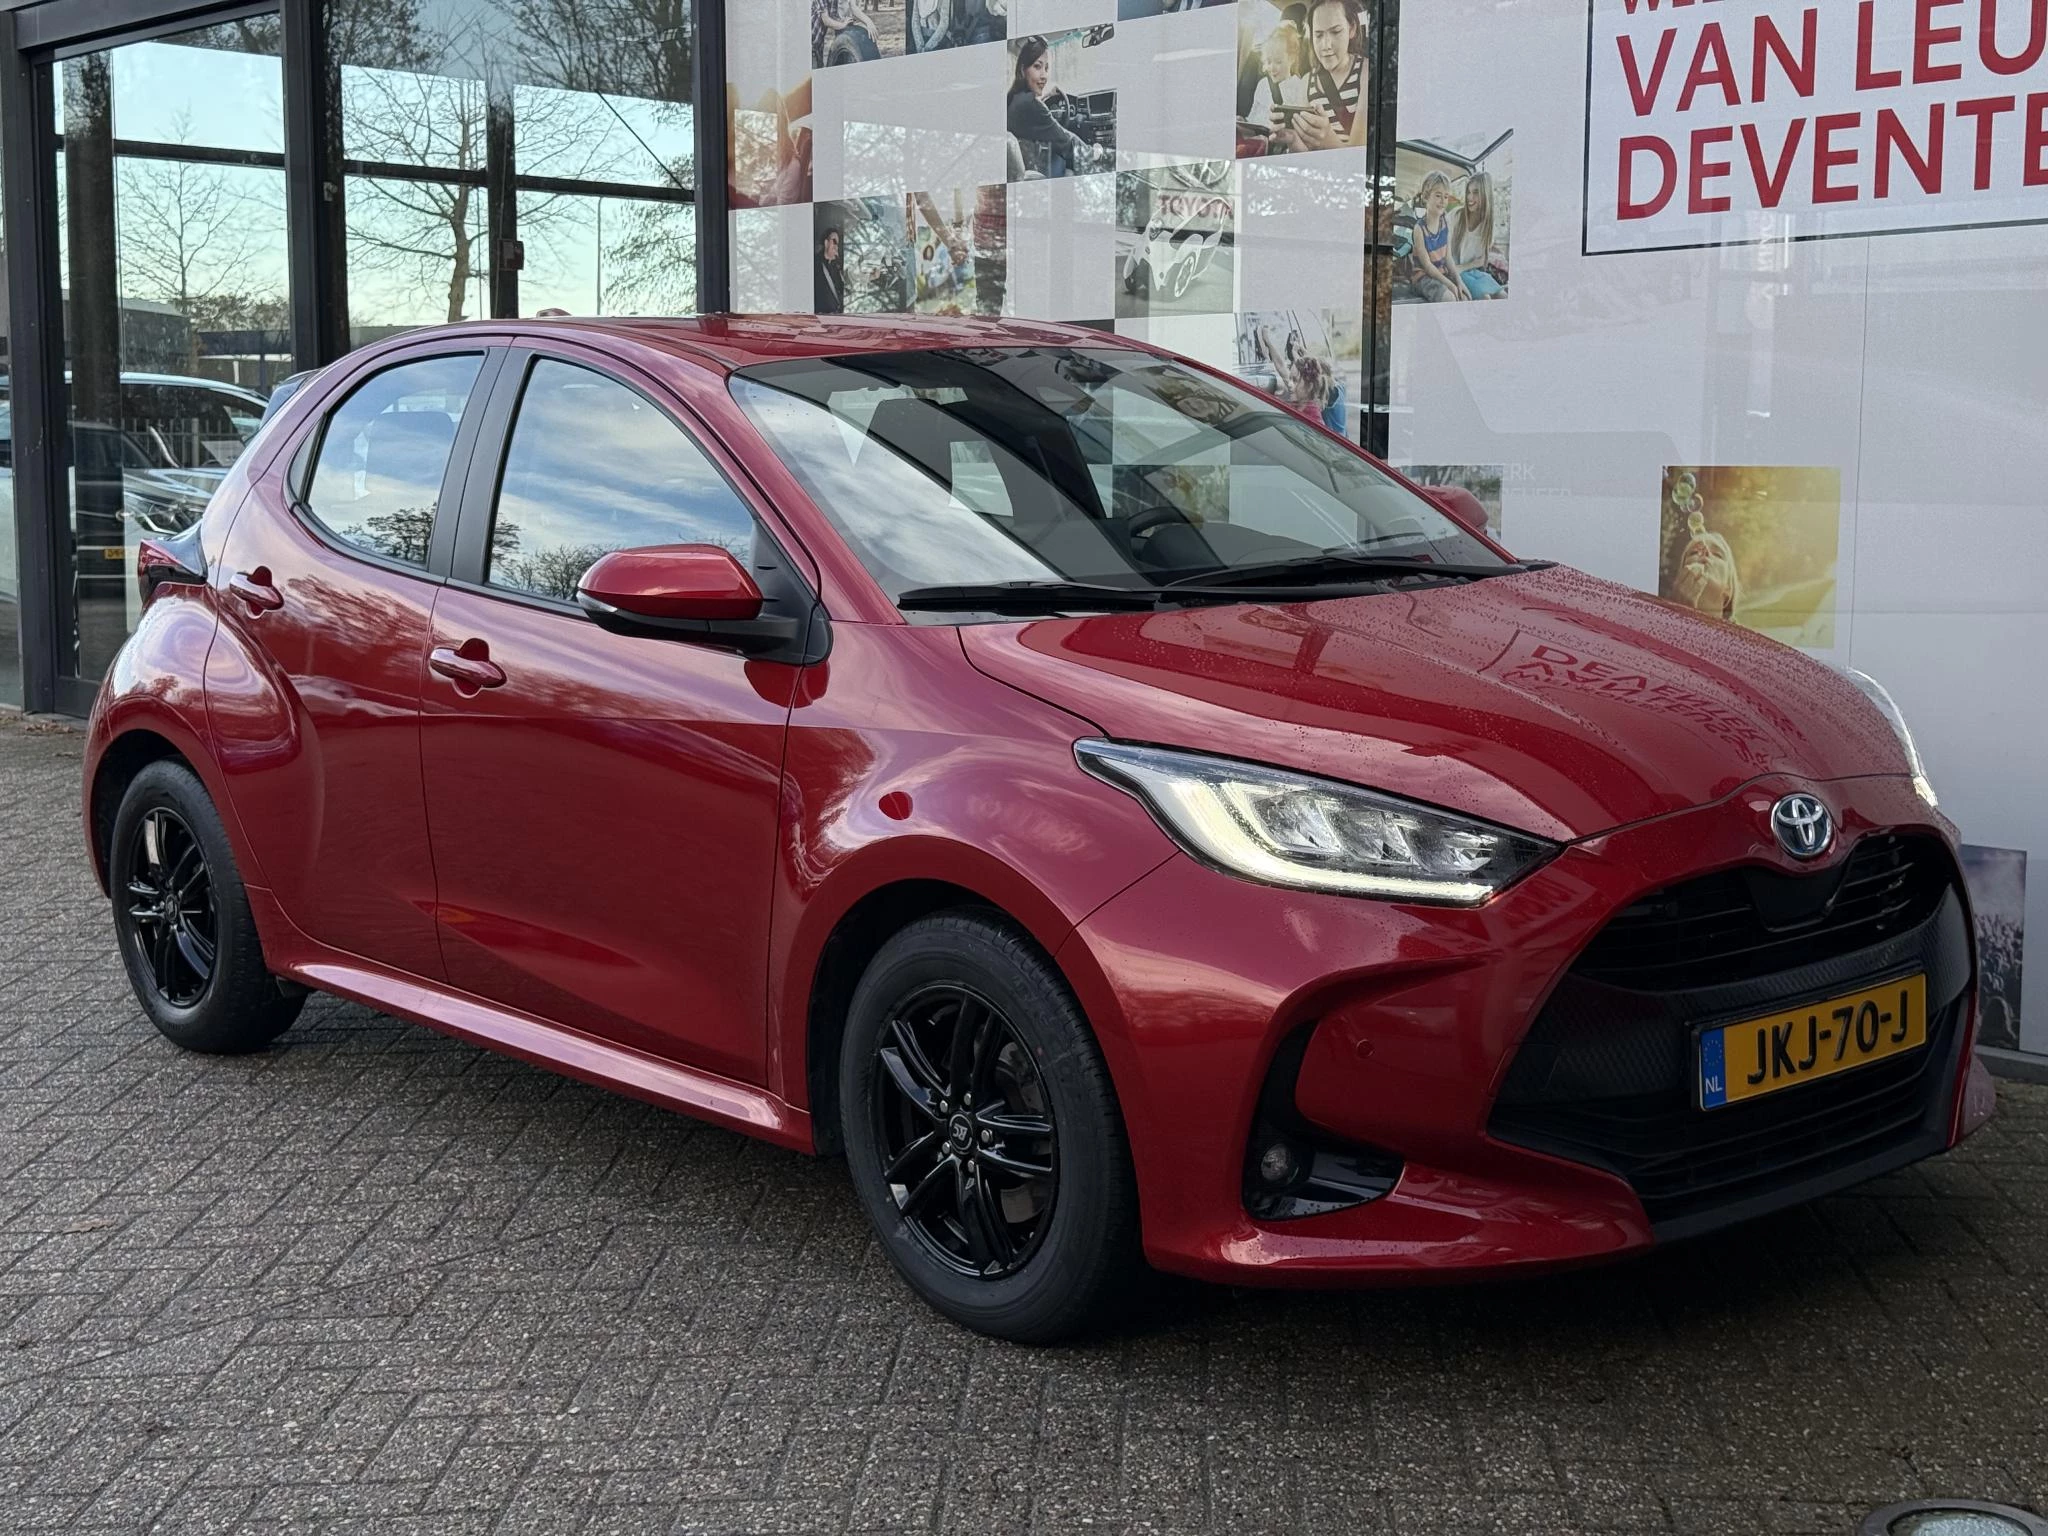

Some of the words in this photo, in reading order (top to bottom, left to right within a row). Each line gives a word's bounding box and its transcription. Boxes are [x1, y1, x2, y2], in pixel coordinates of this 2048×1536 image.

[1616, 8, 1818, 116] VAN
[1855, 0, 2047, 91] LEU
[1747, 990, 1908, 1085] JKJ-70-J
[1705, 1077, 1723, 1094] NL
